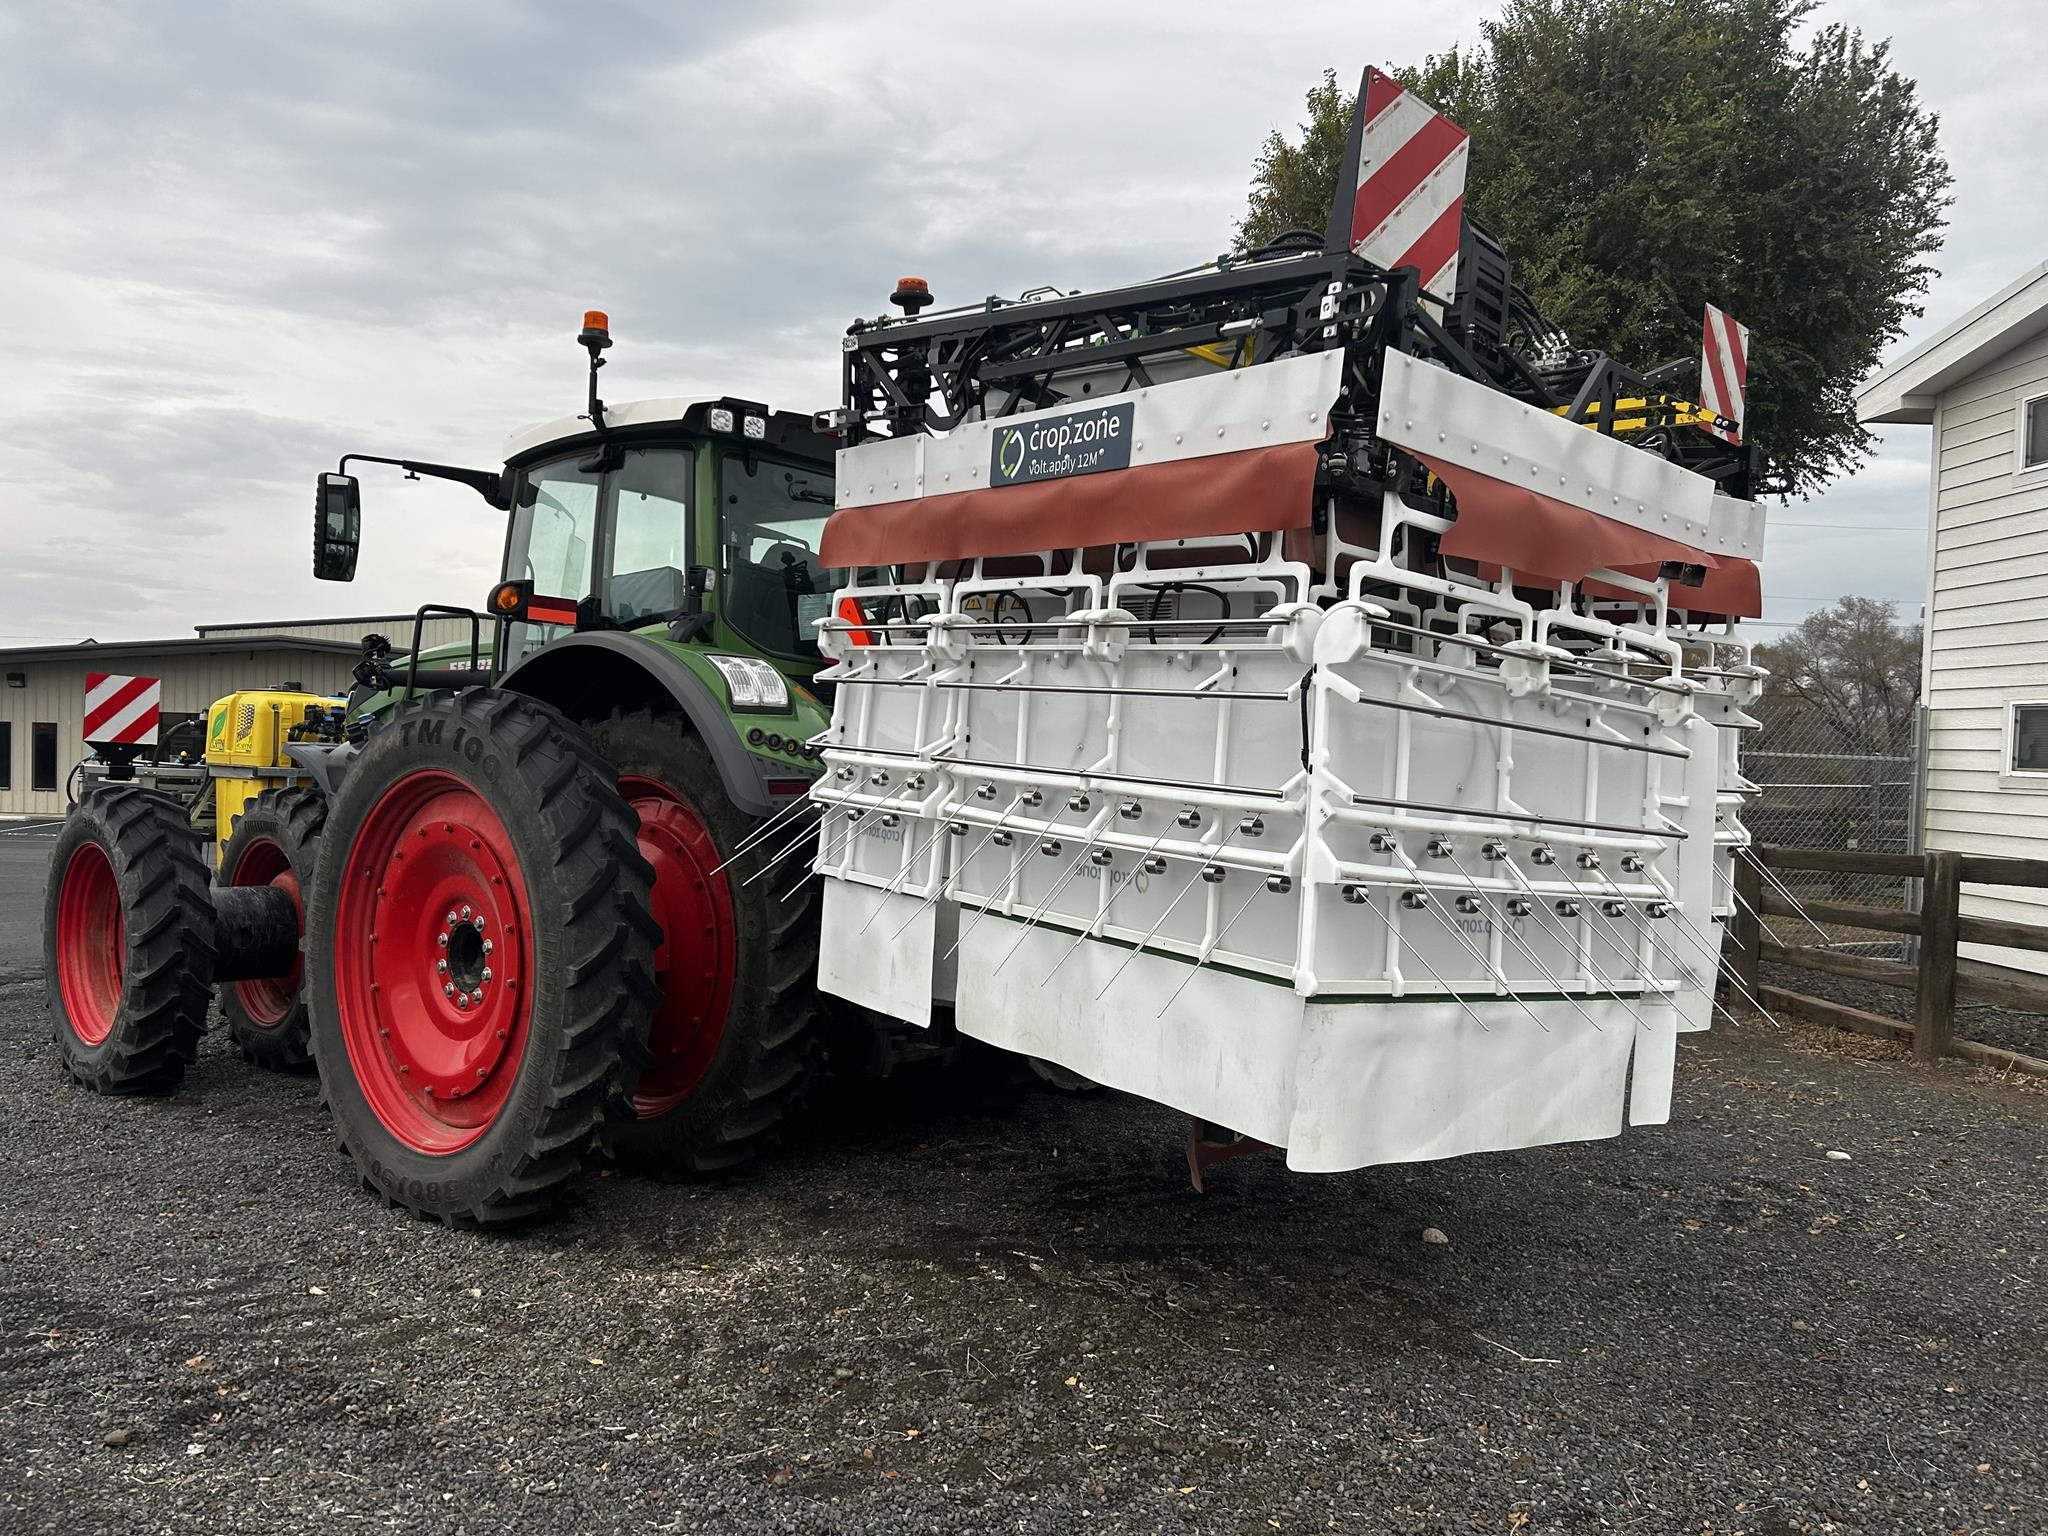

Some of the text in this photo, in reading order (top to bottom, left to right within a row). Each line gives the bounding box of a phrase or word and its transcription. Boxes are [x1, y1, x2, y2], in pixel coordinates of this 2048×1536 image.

[1029, 415, 1120, 455] crop.zone
[1077, 451, 1098, 468] 12M
[400, 718, 447, 748] TM
